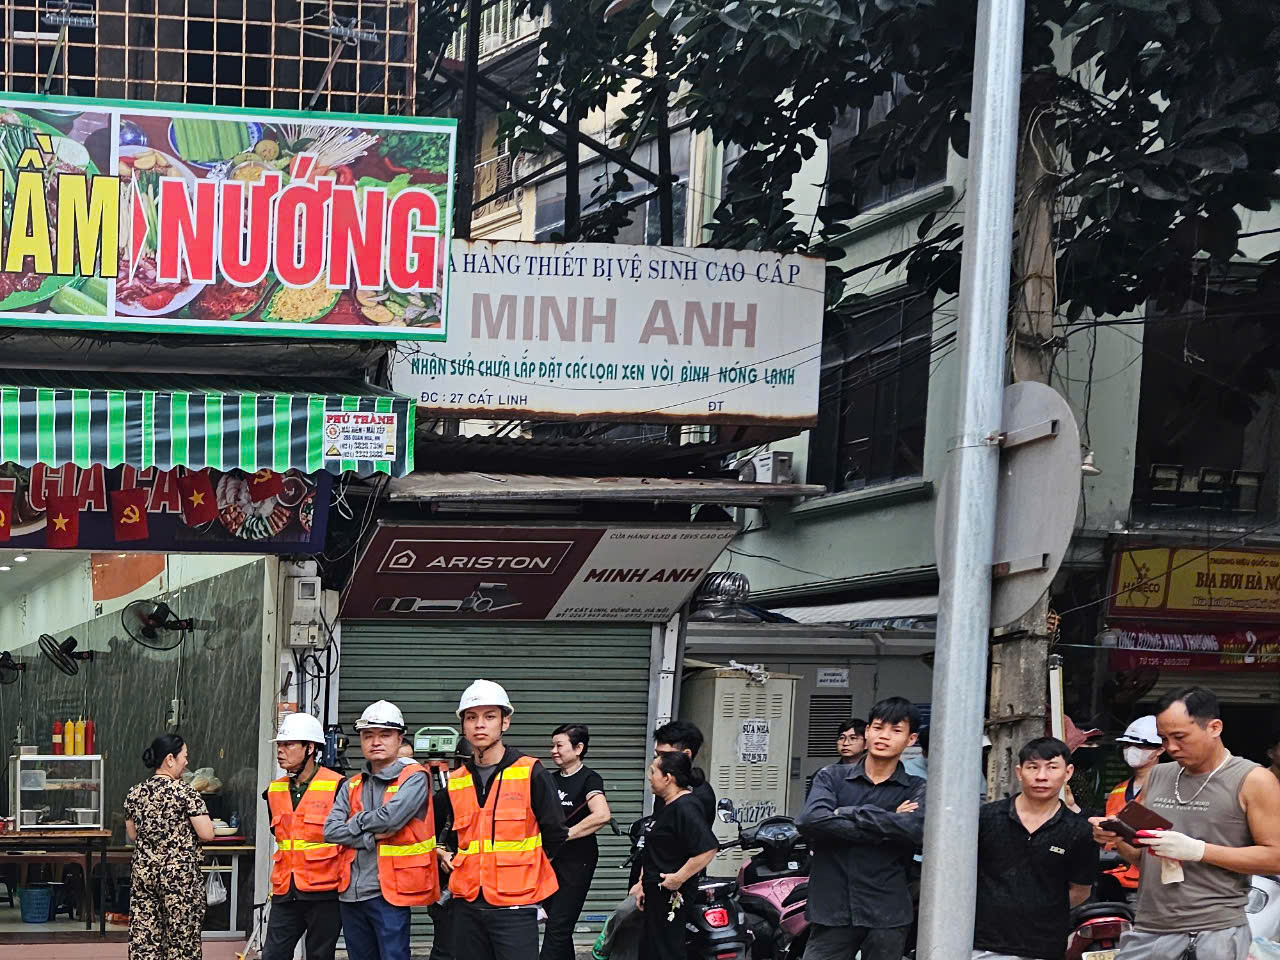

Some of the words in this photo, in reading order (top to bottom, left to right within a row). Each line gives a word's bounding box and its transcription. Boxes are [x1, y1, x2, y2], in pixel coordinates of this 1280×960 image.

[155, 151, 441, 293] NƯỚNG
[462, 246, 522, 275] HÀNG
[525, 246, 587, 277] THIẾT
[592, 258, 614, 282] BỊ
[617, 253, 642, 282] VỆ
[648, 259, 697, 280] SINH
[705, 261, 746, 282] CAO
[471, 292, 617, 344] MINH
[638, 299, 758, 348] ANH
[450, 351, 474, 376] SỬA
[514, 349, 536, 378] LẮP
[538, 356, 562, 383] ĐẶT
[621, 363, 645, 381] XEN
[651, 357, 674, 381] VÒI
[680, 360, 710, 383] BÌNH
[719, 360, 758, 384] NÓNG
[764, 367, 795, 389] LẠNH
[450, 393, 464, 404] 27
[468, 388, 494, 405] CÁT
[498, 394, 528, 405] LINH
[708, 401, 725, 412] ĐT
[326, 412, 351, 424] PHÚ
[353, 413, 395, 425] THÀNH
[426, 555, 552, 569] ARISTON
[583, 568, 650, 583] MINH
[646, 568, 704, 583] ANH
[1195, 571, 1217, 588] BIA
[1245, 571, 1263, 591] HÀ
